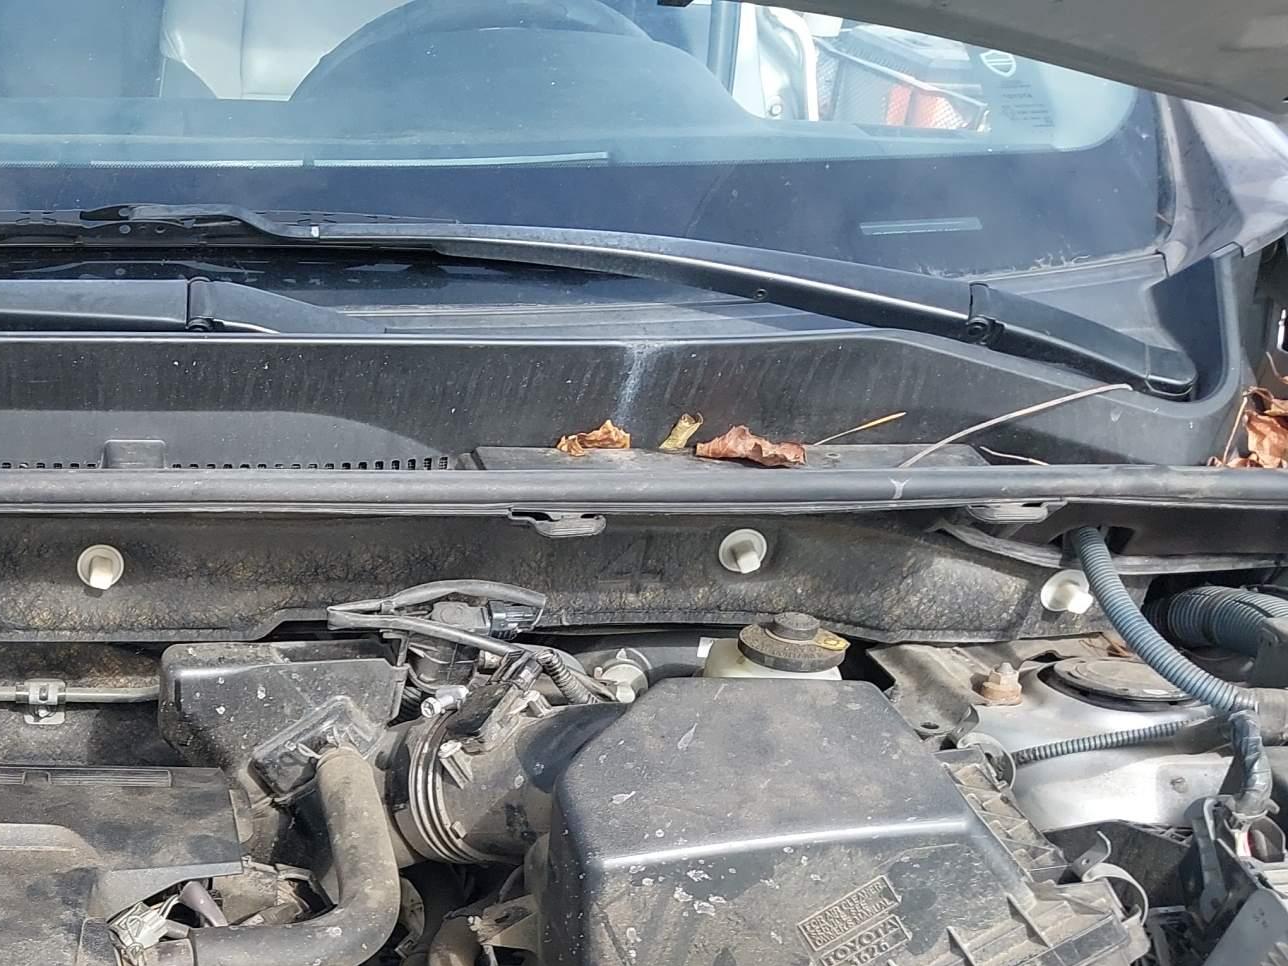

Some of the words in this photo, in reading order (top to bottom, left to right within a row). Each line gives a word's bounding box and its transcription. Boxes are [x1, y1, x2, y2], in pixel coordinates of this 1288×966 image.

[803, 915, 825, 931] FOR
[823, 905, 842, 920] AIR
[840, 881, 883, 910] CLEANER
[809, 911, 849, 938] SERVICE
[849, 900, 868, 915] SEE
[853, 896, 894, 924] MANUAL
[825, 918, 900, 966] TOYOTA
